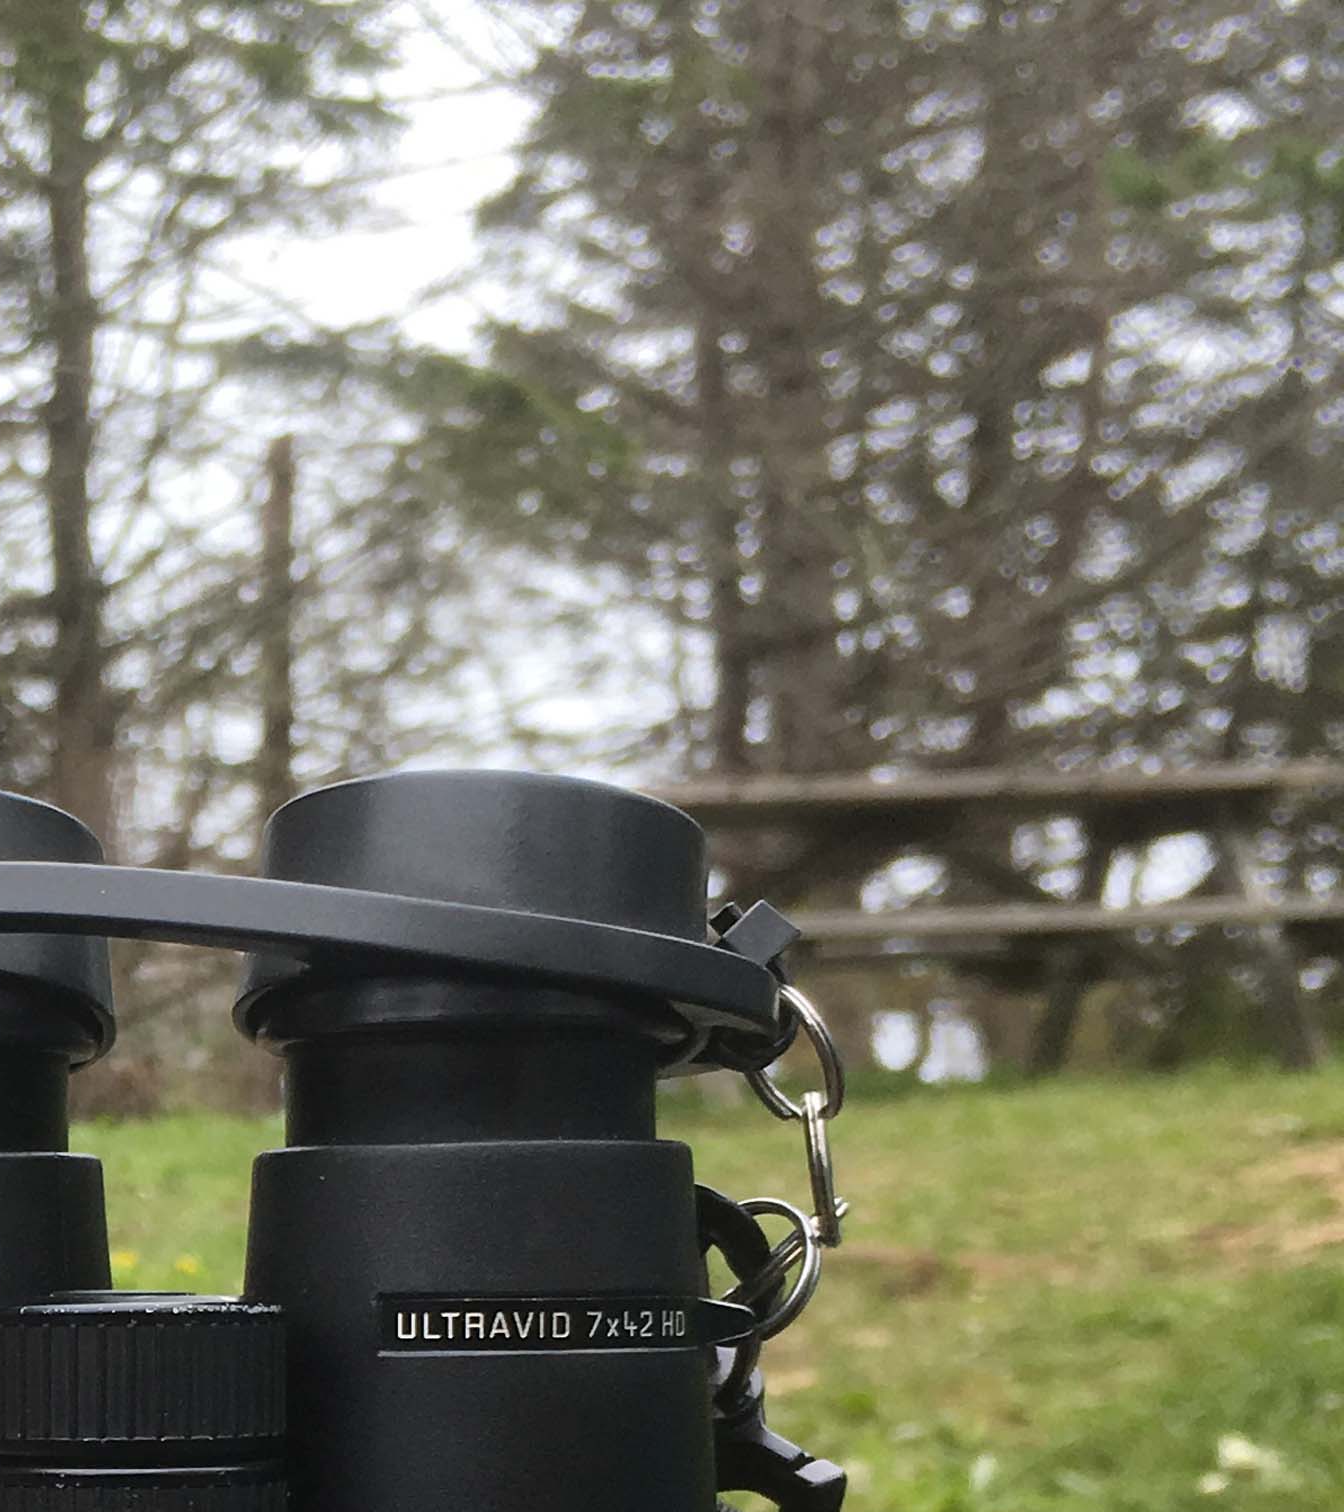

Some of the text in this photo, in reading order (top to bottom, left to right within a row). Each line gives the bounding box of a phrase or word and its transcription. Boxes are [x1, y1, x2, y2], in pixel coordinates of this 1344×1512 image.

[397, 1310, 686, 1340] ULTRAVID 7x42 HD
